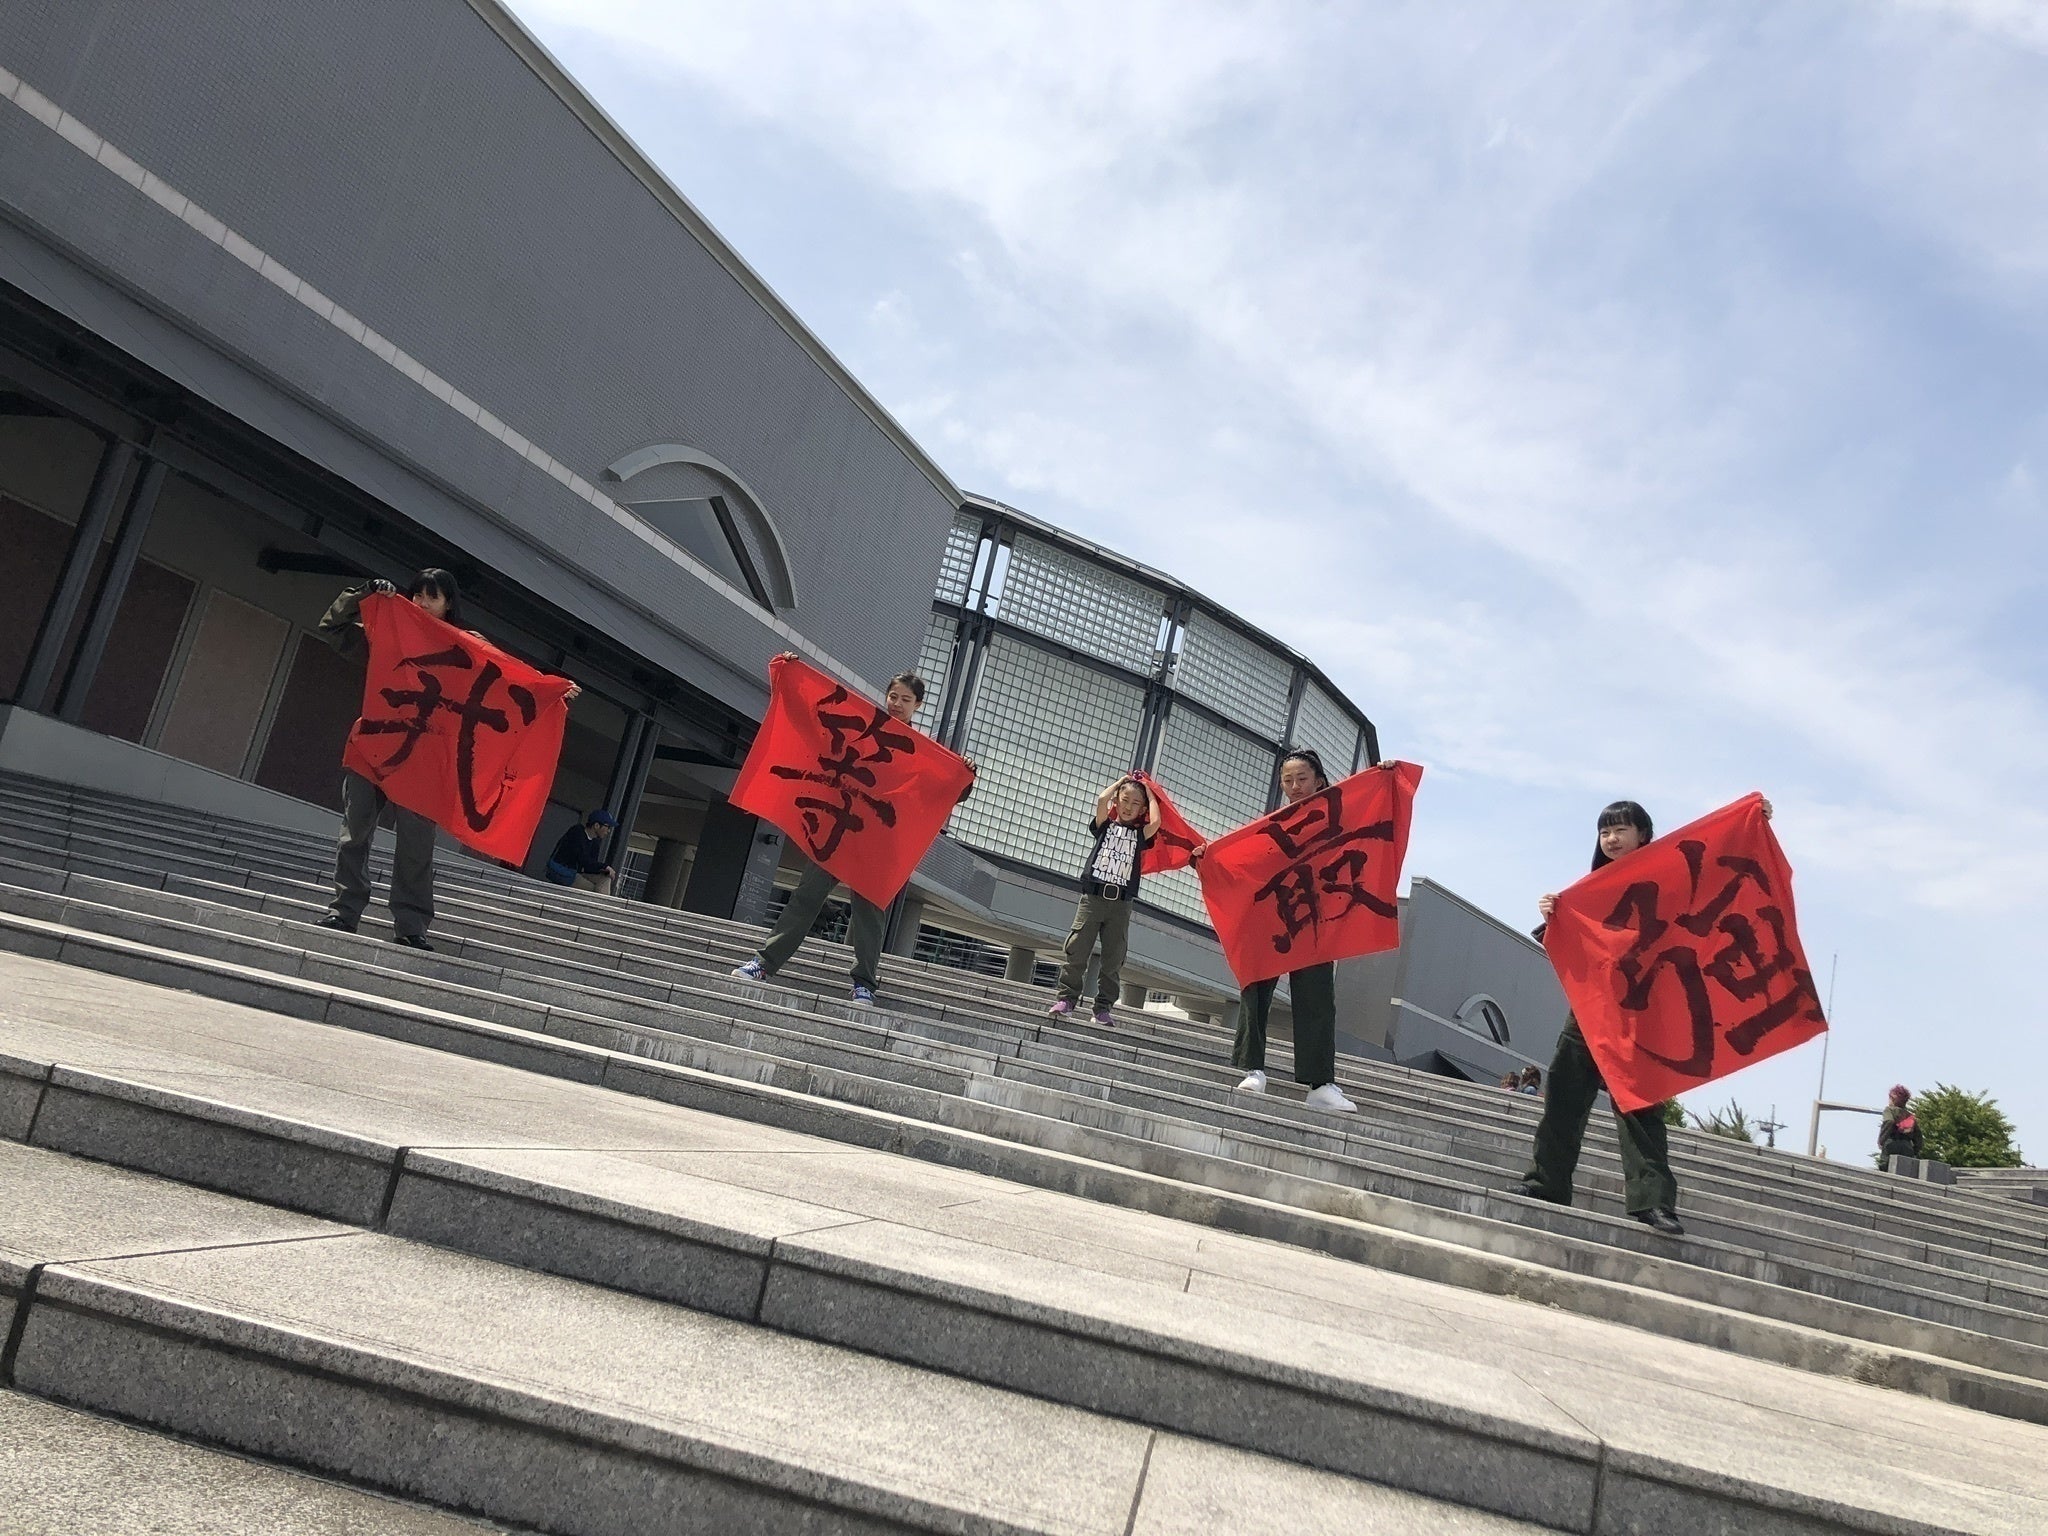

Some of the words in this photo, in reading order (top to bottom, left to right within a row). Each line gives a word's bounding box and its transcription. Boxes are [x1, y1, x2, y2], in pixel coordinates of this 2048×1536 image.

[359, 645, 536, 833] 我
[769, 684, 915, 863] 等
[1101, 833, 1138, 857] SWAG
[1253, 786, 1398, 954] 最
